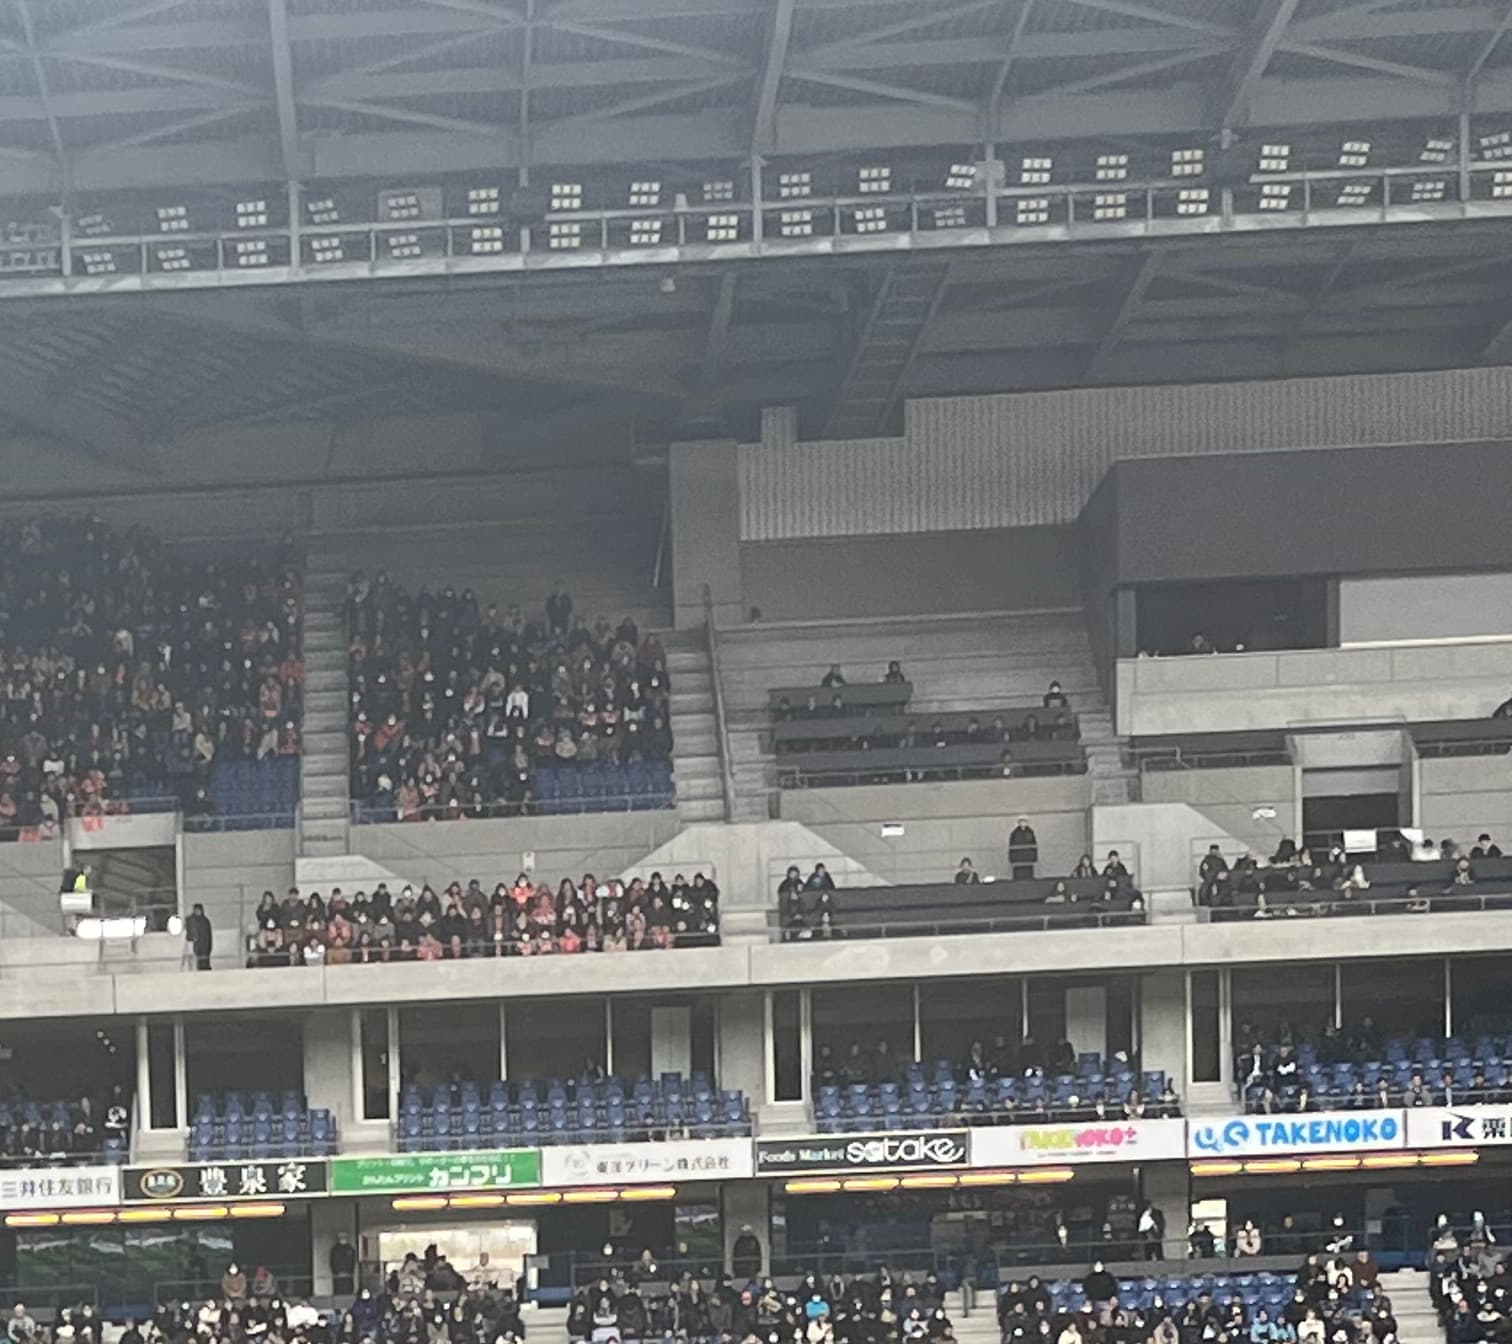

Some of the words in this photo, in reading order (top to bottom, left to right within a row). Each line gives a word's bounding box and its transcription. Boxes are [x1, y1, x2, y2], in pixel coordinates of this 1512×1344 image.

[1255, 1118, 1398, 1146] TAKENOKO
[846, 1136, 965, 1163] satake
[1, 1177, 113, 1199] 三井住友銀行
